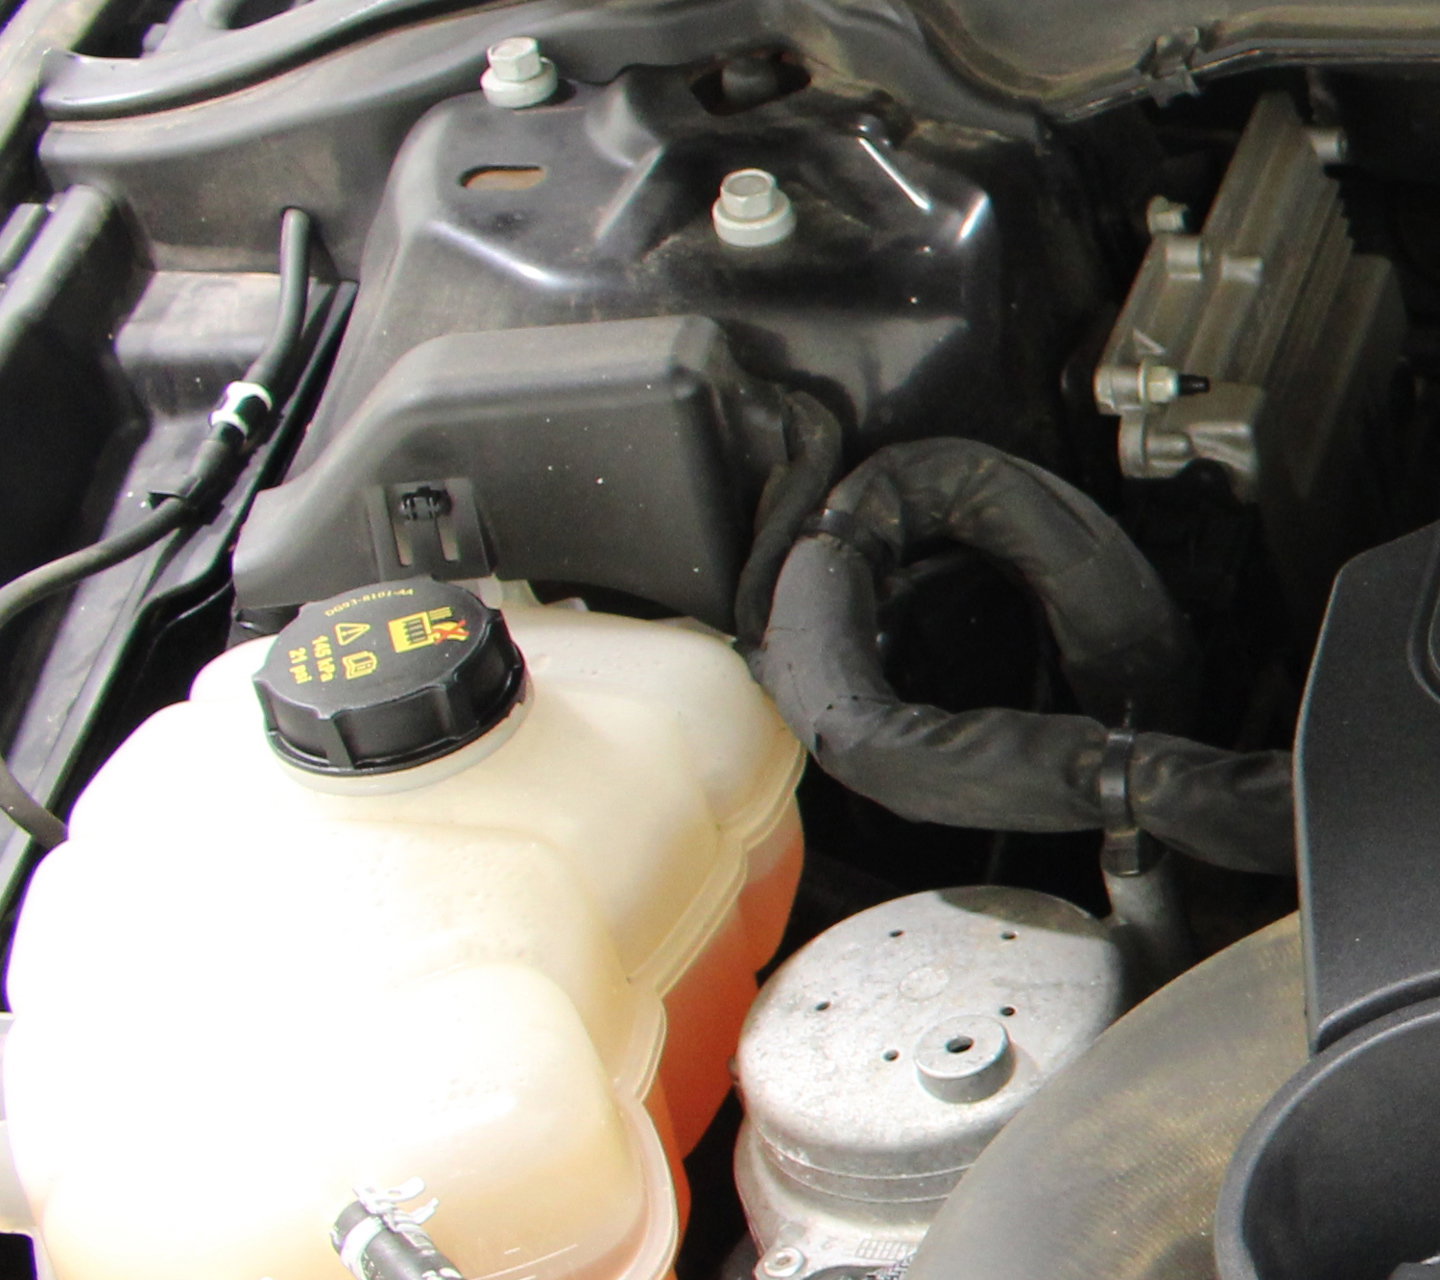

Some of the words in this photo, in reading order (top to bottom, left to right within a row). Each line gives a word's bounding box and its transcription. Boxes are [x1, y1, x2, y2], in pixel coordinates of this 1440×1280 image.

[288, 646, 308, 665] 21
[311, 634, 333, 659] 145
[289, 663, 313, 685] psi
[316, 656, 337, 683] kPa
